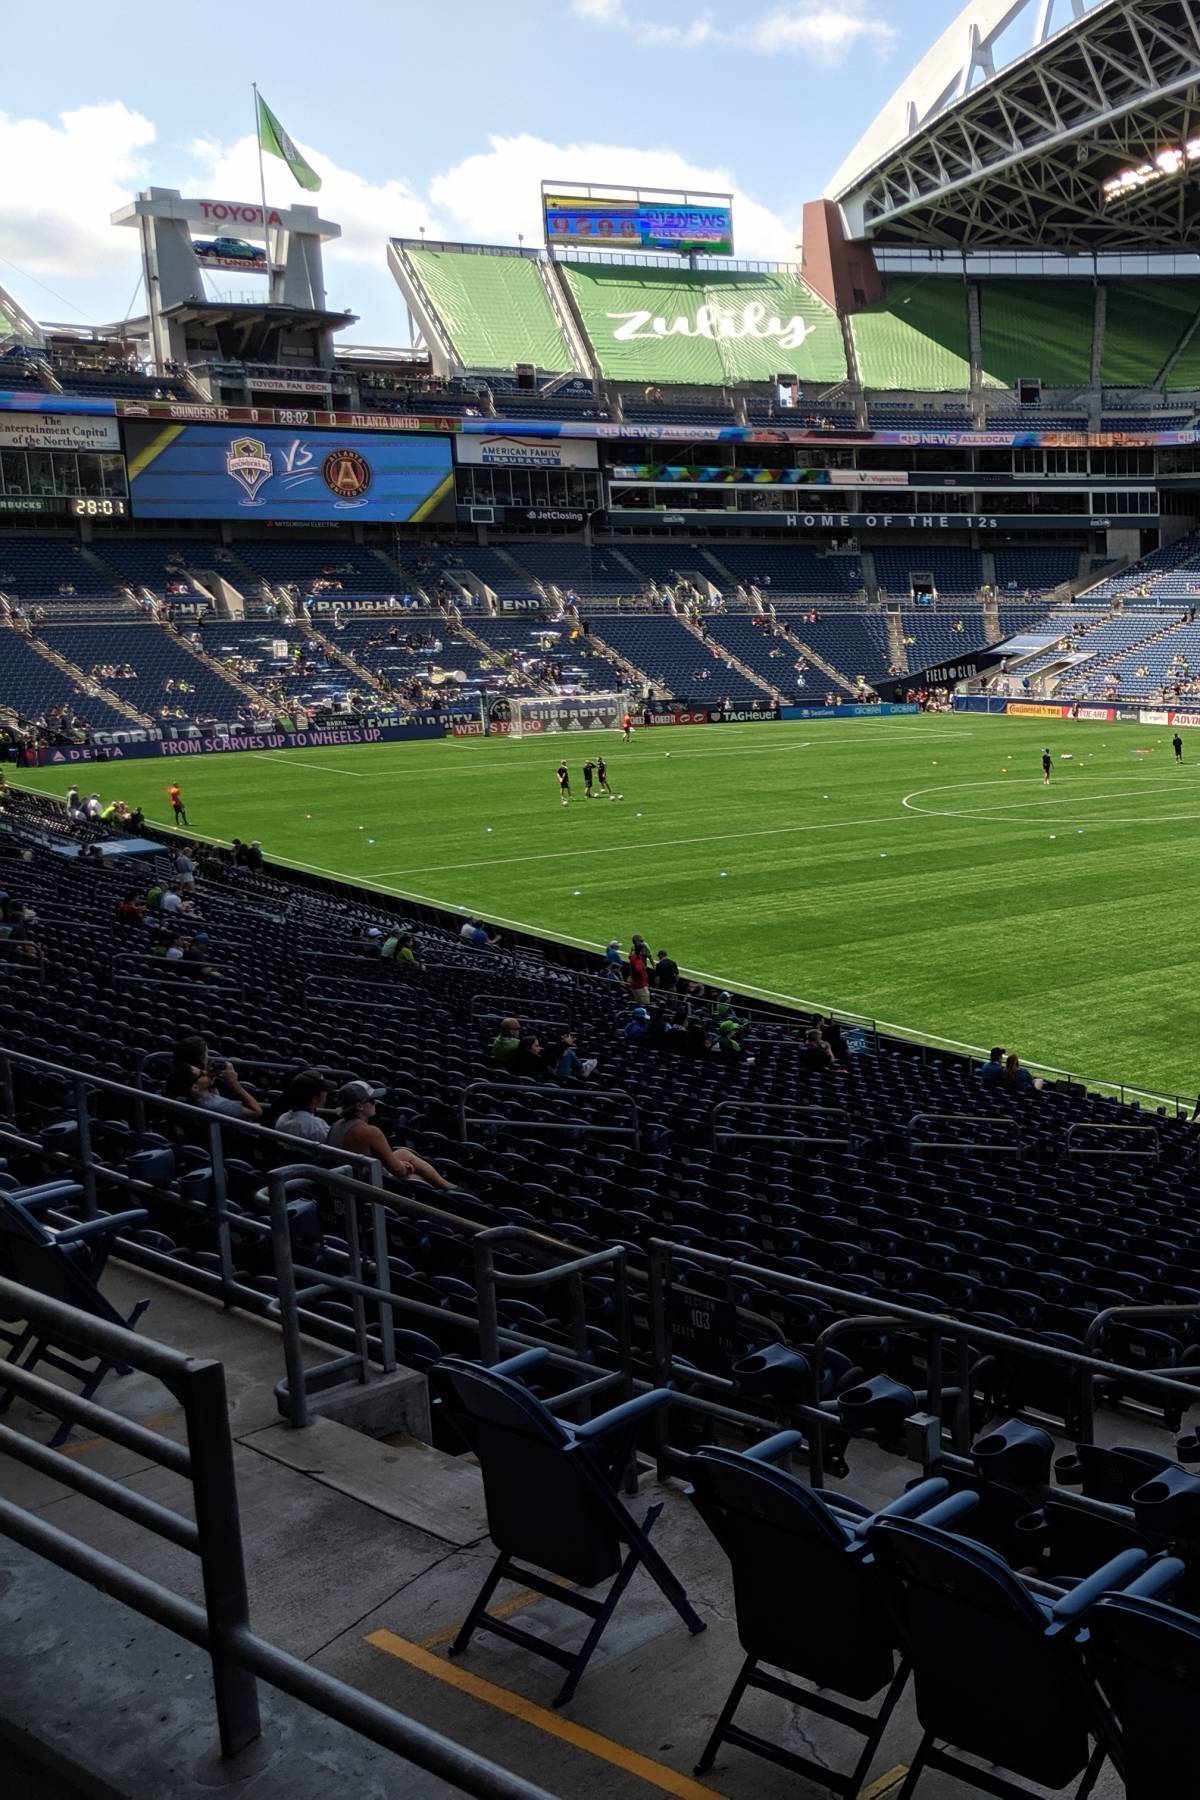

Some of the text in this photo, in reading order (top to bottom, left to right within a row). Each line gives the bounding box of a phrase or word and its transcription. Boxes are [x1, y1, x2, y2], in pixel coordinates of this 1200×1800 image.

[200, 202, 284, 226] TOYOTA
[674, 212, 726, 228] NEWS
[607, 302, 816, 348] zulily
[251, 380, 329, 392] TOYOTA FAN DECK
[42, 415, 62, 426] The
[170, 406, 420, 429] SOUNDERS FC 0 28:02 0 ATLANTA UNITED
[73, 426, 108, 438] Capital
[620, 426, 659, 437] NEWS
[12, 435, 24, 444] of
[25, 435, 41, 445] the
[43, 437, 96, 447] Northwest
[921, 434, 957, 444] NEWS
[281, 439, 313, 473] VS
[328, 450, 364, 464] ATLANTA
[482, 446, 560, 457] AMERICAN FAMILY
[487, 457, 555, 465] INSURANCE
[328, 482, 357, 498] UNITED
[76, 500, 125, 515] 28:01
[537, 511, 583, 521] JetClosing
[786, 515, 998, 528] HOME OF THE 12s
[310, 521, 340, 529] ELECTRIC
[503, 600, 540, 610] END
[925, 664, 977, 683] FIELD CLUB
[1009, 704, 1042, 715] Continental
[161, 739, 201, 756] FROM
[205, 734, 265, 752] SCARVES
[267, 734, 286, 748] UP
[288, 733, 307, 747] TO
[310, 728, 362, 746] WHEELS
[364, 727, 384, 742] UP.
[691, 1308, 711, 1330] 103
